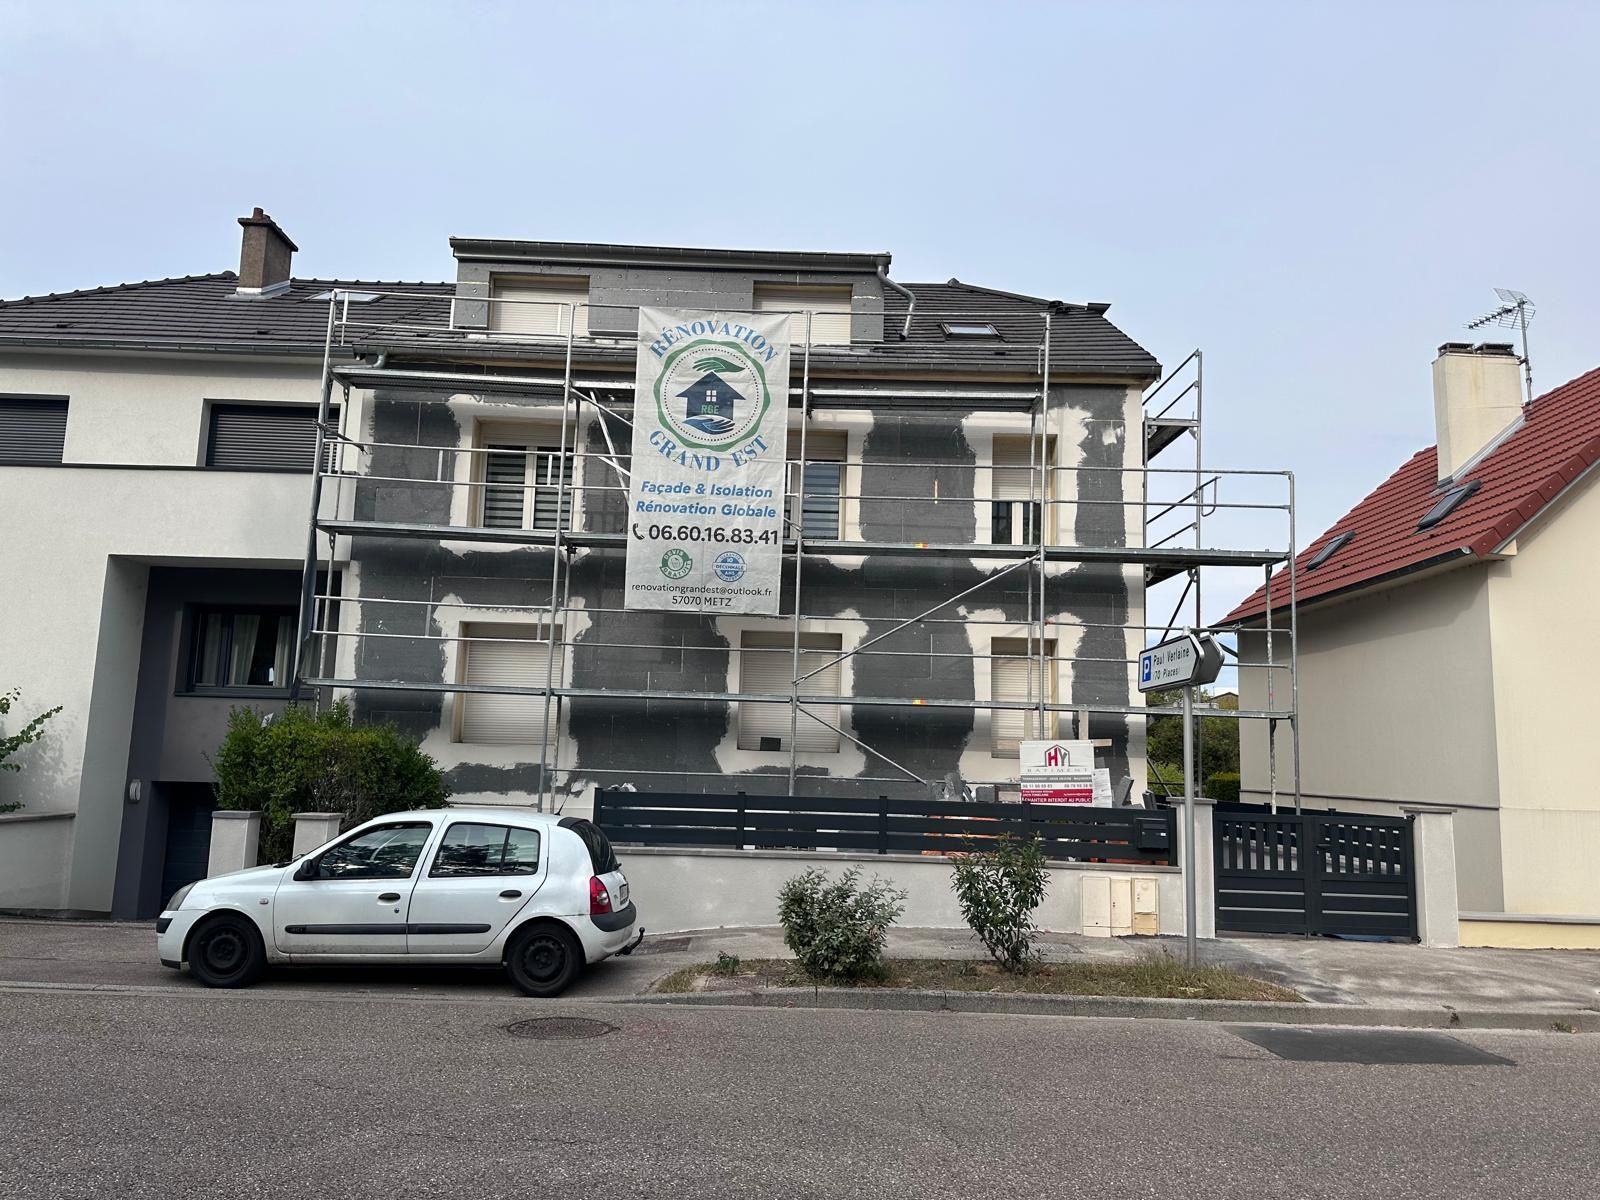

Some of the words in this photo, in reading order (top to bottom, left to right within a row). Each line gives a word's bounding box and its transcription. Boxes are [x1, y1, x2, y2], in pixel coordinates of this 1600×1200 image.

[650, 320, 778, 362] RÉNOVATION
[701, 404, 720, 415] RGE
[649, 430, 720, 472] GRAND
[731, 435, 768, 468] EST
[641, 481, 691, 495] Façade
[695, 483, 706, 495] &
[710, 484, 773, 498] Isolation
[636, 501, 716, 515] Rénovation
[721, 504, 776, 518] Globale
[648, 524, 778, 545] 06.60.16.83.41
[664, 549, 684, 560] DEVIS
[663, 562, 691, 578] GRATUIT
[631, 584, 772, 597] renovationgrandest@outlook.fr
[672, 596, 701, 605] 57070
[704, 598, 732, 607] METZ
[1153, 652, 1165, 666] Paul
[1167, 646, 1190, 662] Verlaine
[1048, 747, 1068, 767] HY
